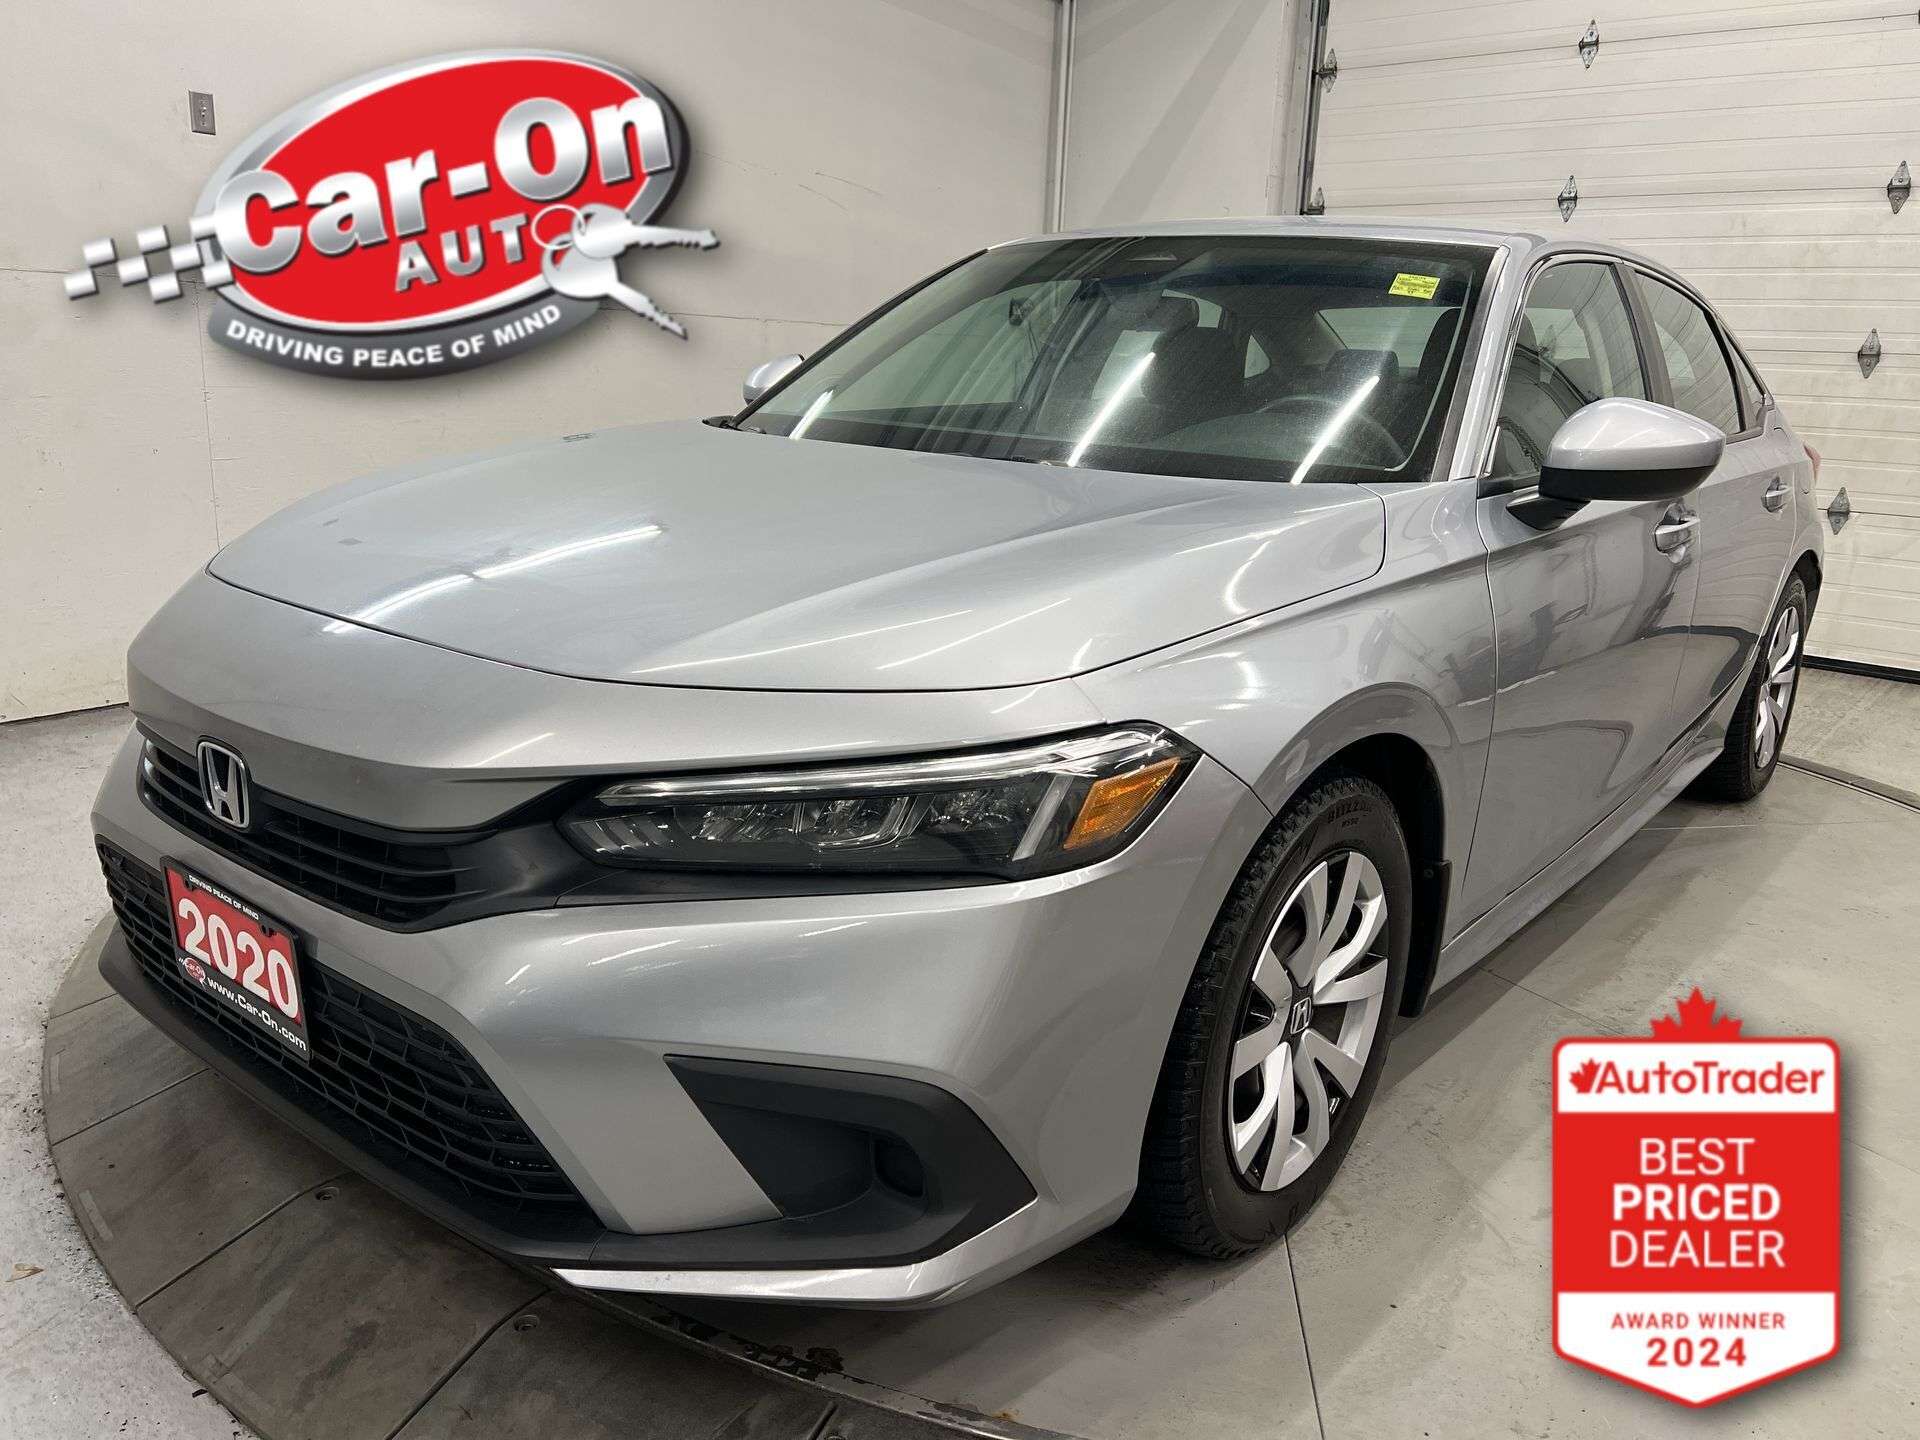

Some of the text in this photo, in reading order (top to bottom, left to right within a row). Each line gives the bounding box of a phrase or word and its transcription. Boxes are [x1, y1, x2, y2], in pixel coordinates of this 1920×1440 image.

[188, 874, 259, 920] DRIVING PEACE OF MIND
[178, 898, 299, 1019] 2020
[207, 977, 307, 1051] www.Car-On.com
